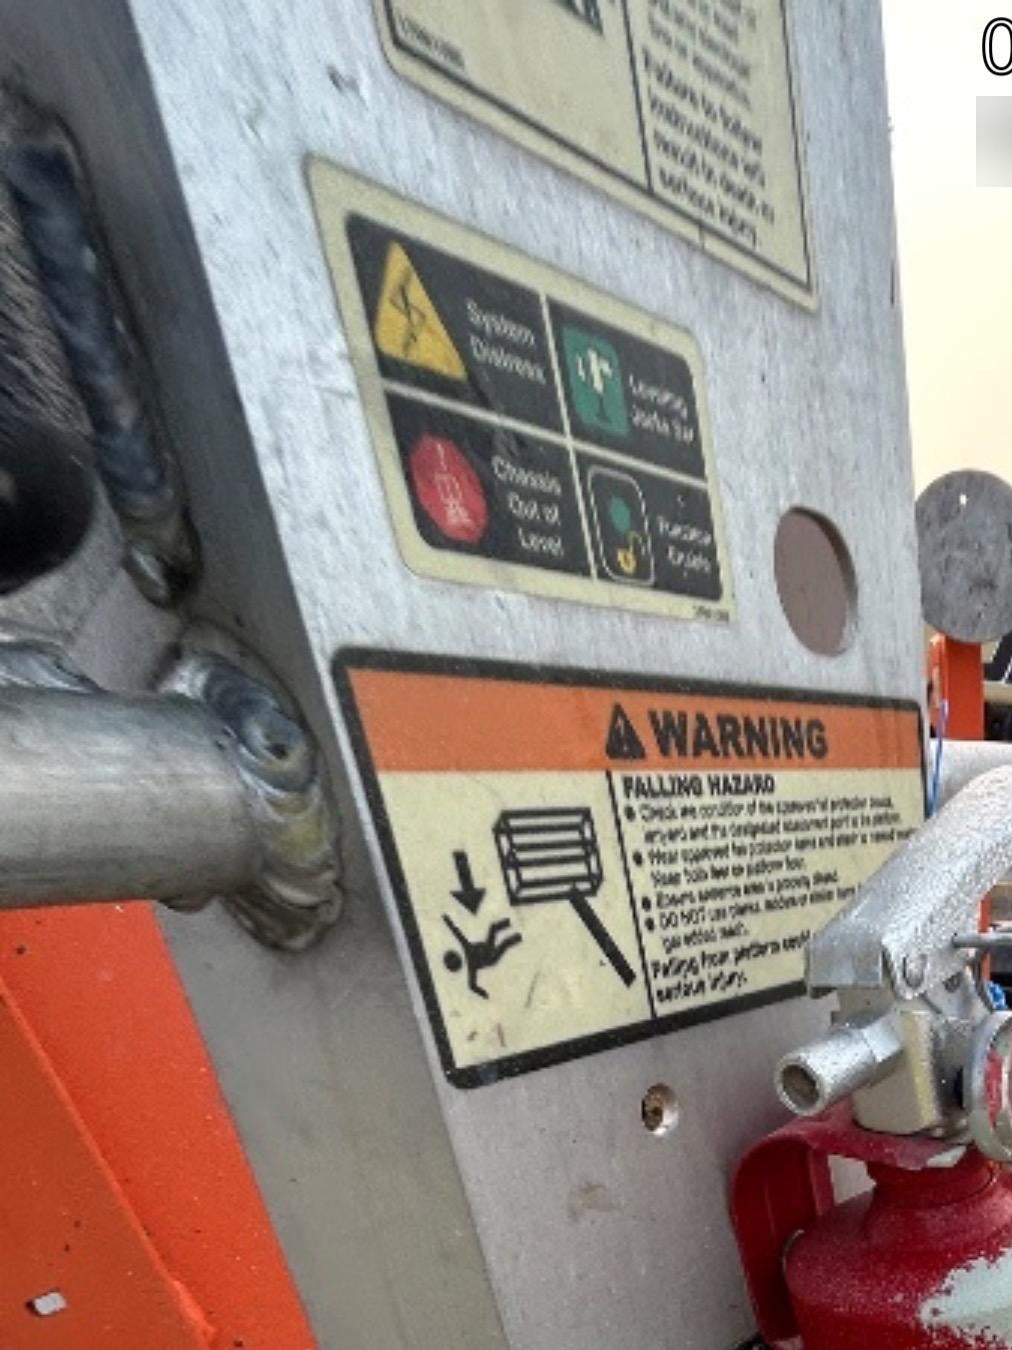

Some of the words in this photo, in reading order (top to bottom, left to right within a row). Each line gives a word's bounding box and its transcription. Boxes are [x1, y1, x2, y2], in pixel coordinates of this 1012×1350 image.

[466, 297, 536, 347] System
[469, 333, 547, 385] Distress
[491, 455, 563, 497] Chassis
[508, 491, 541, 521] Out
[517, 527, 564, 557] Level
[647, 709, 829, 759] WARNING
[622, 773, 702, 799] FALLING
[707, 774, 775, 796] HAZARD
